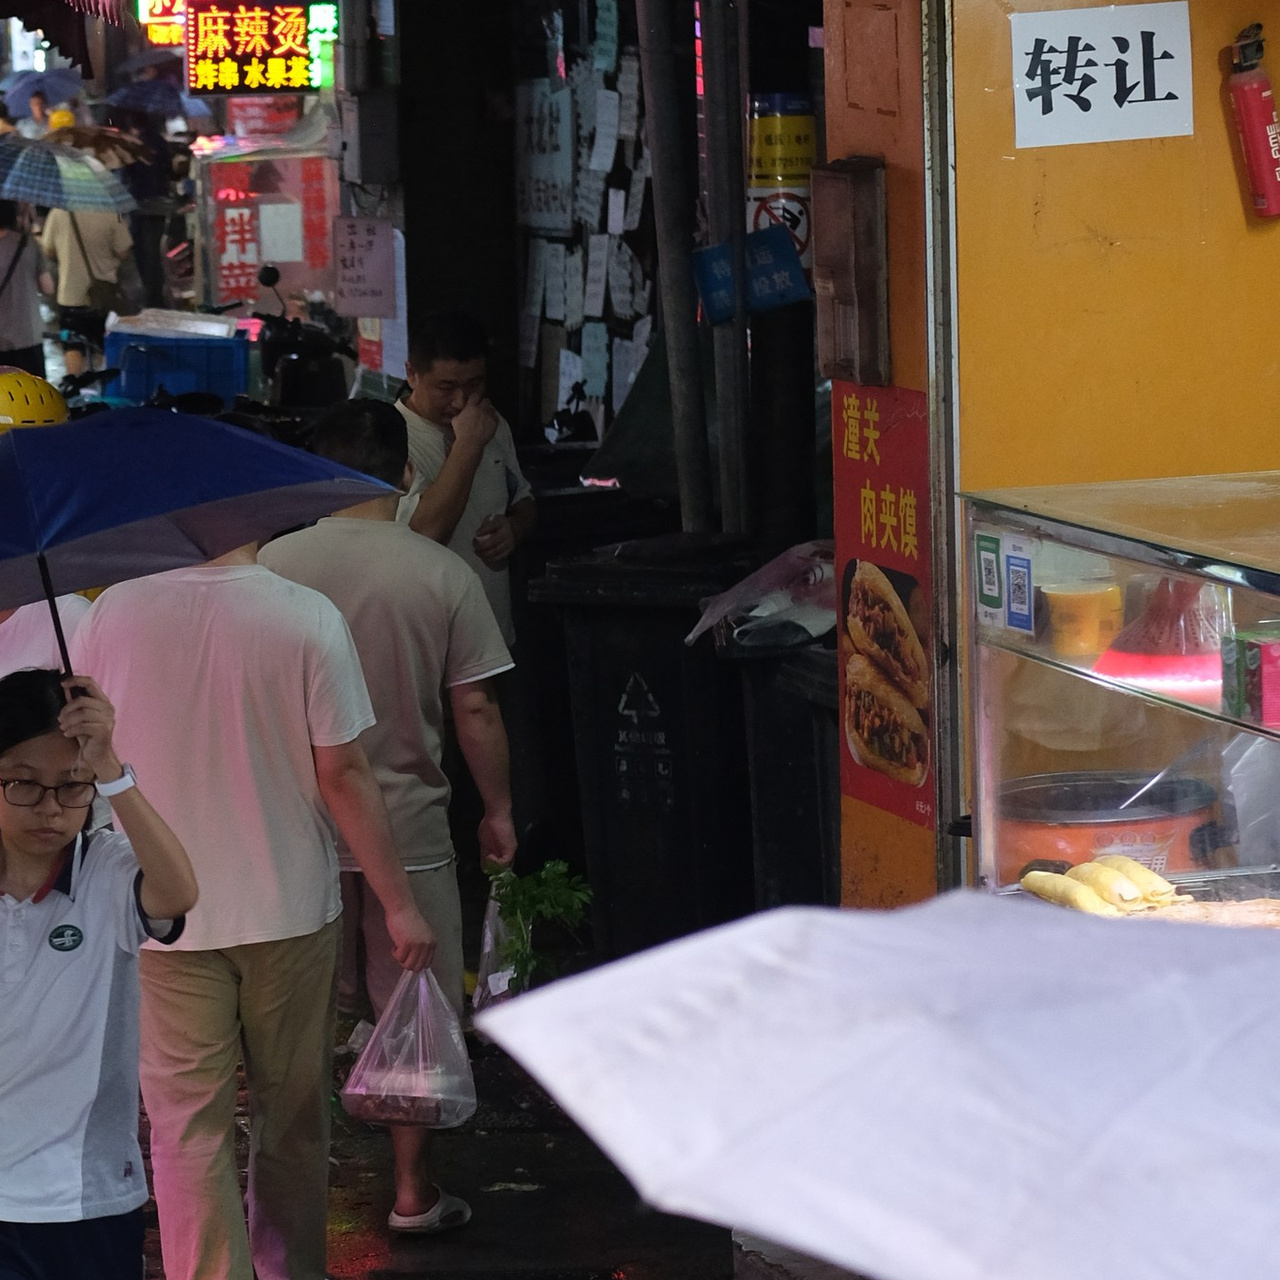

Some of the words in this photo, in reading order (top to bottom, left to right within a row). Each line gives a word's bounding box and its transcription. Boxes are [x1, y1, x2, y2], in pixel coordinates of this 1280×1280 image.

[196, 5, 309, 58] 麻辣烫
[195, 58, 239, 90] 炸串
[242, 56, 310, 89] 水果茶
[1024, 31, 1179, 116] 转让
[842, 392, 881, 466] 潼关
[860, 478, 919, 560] 肉夹馍
